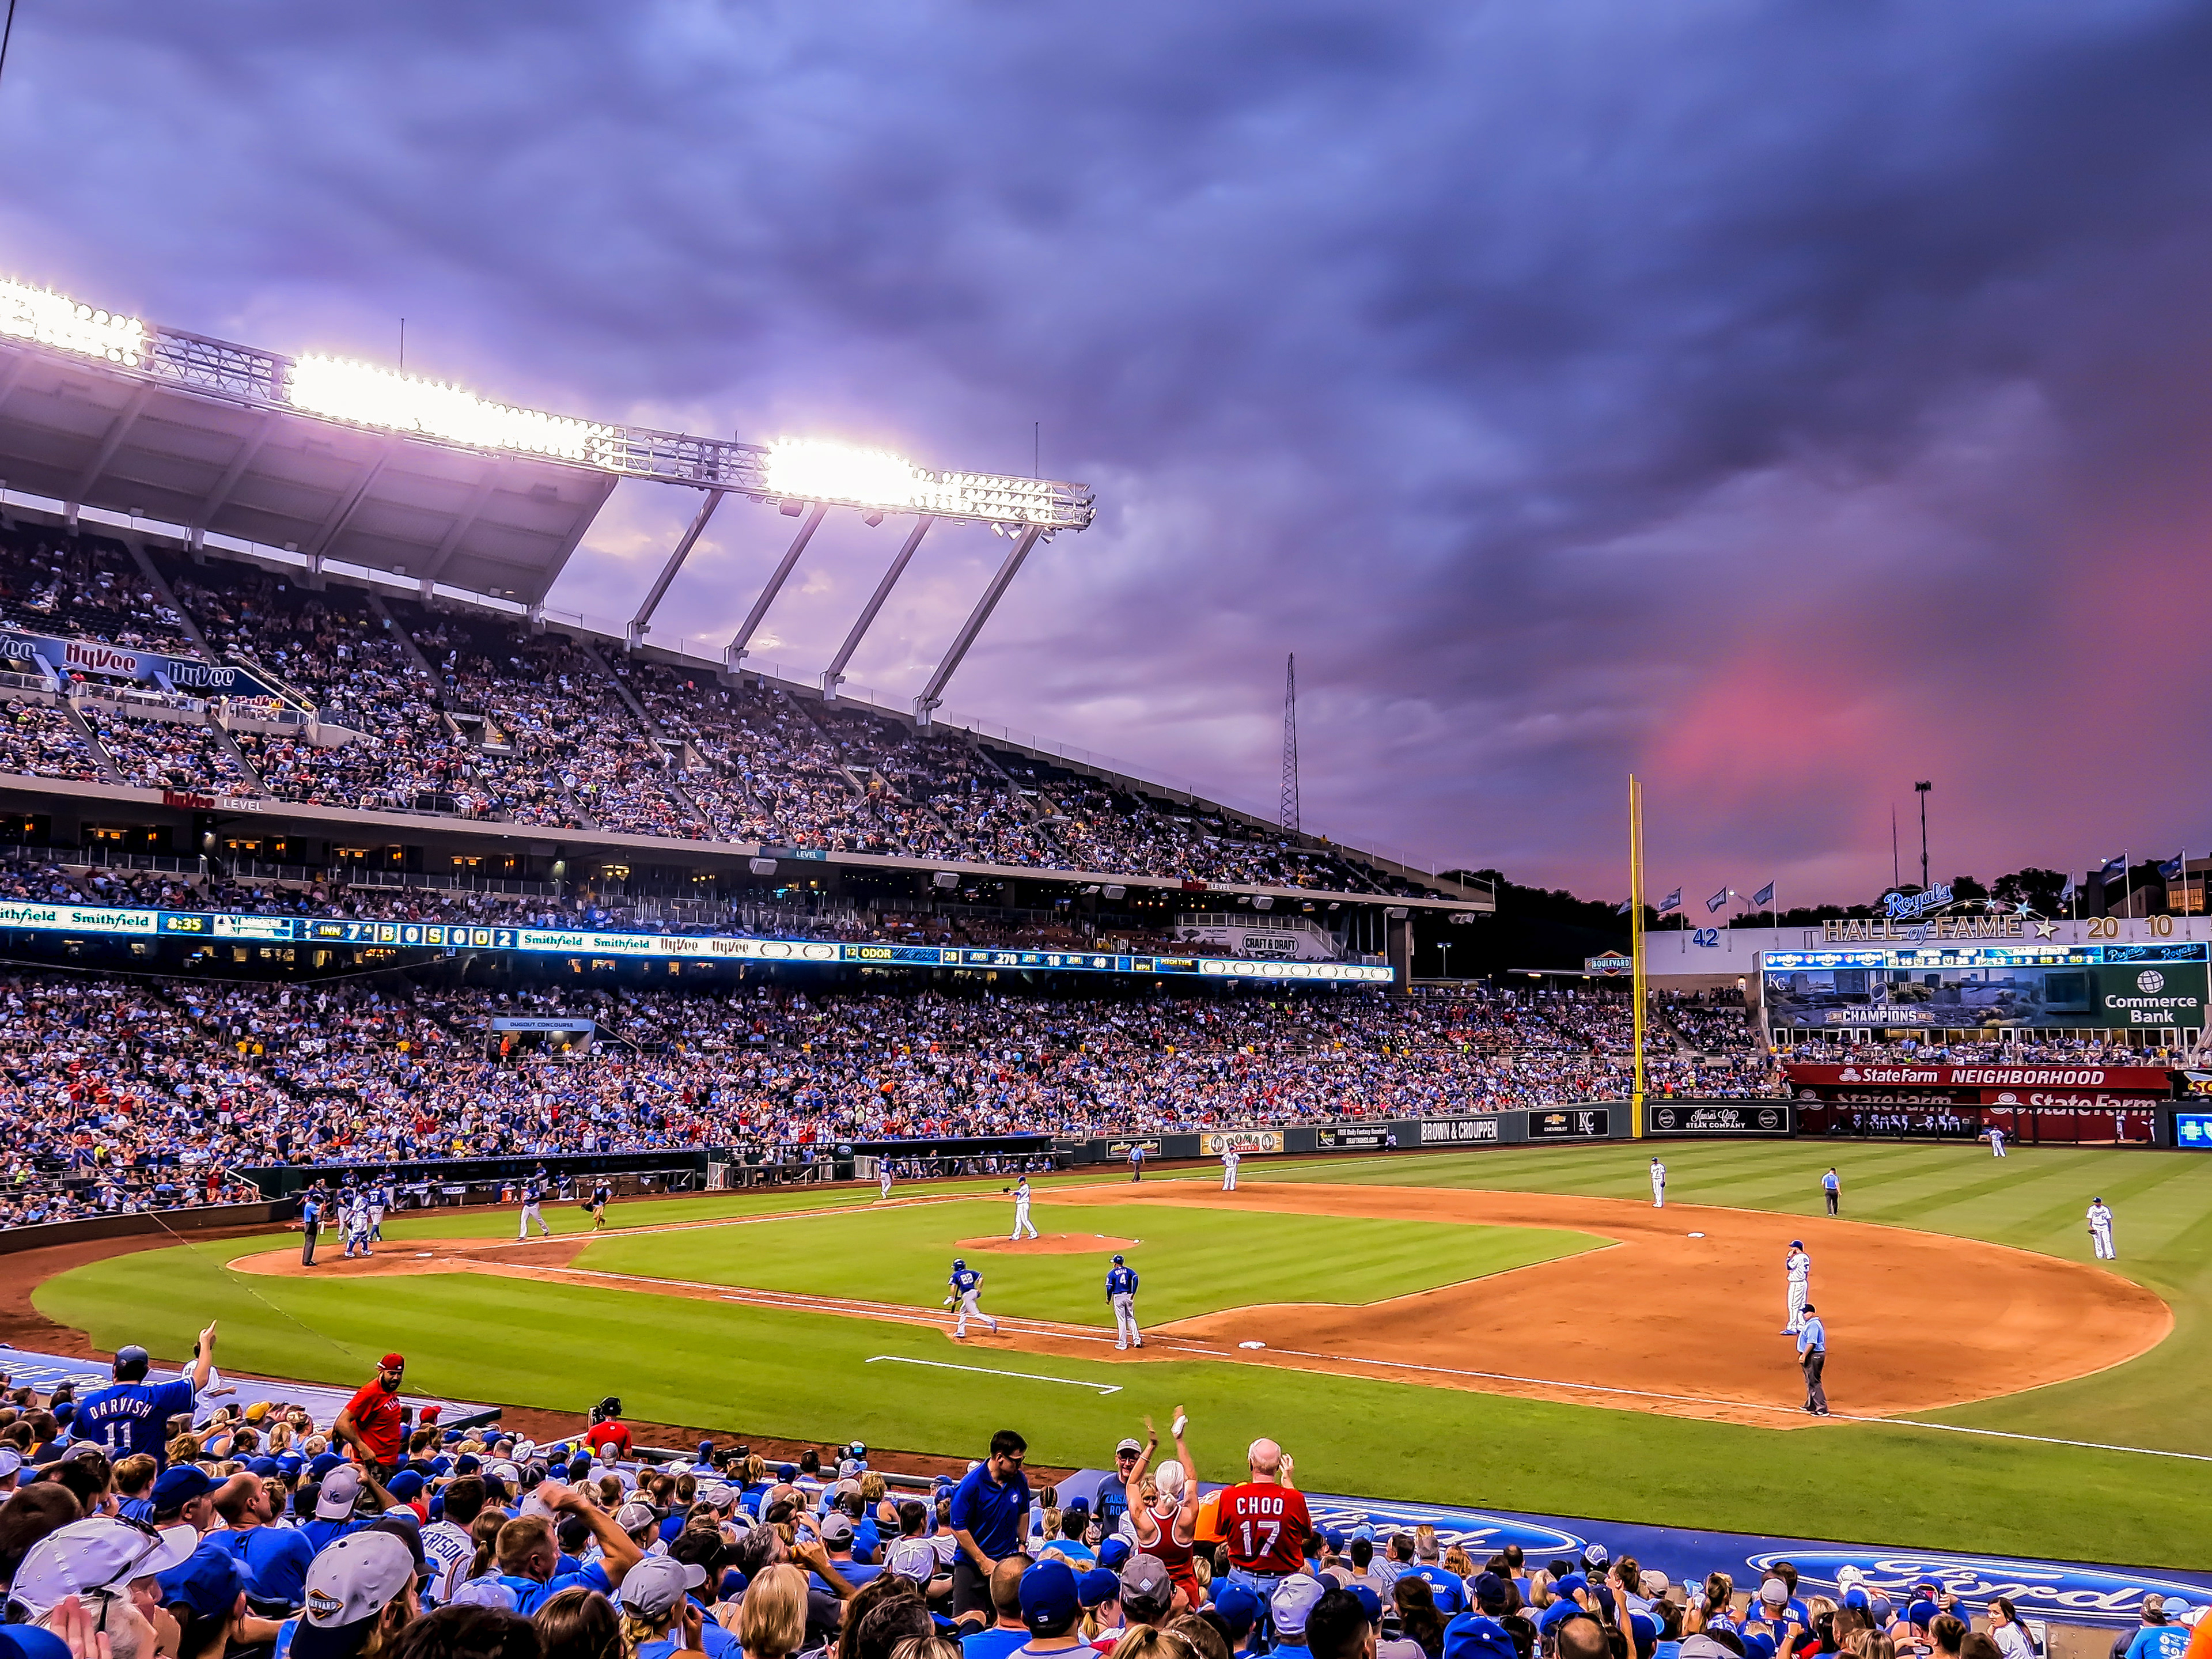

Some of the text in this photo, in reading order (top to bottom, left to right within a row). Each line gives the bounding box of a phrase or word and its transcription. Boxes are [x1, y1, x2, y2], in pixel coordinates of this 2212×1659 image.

[64, 642, 137, 673] HyVee
[168, 661, 236, 687] HyVee
[224, 798, 263, 812] LEVEL
[796, 850, 817, 859] LEVEL
[1211, 882, 1231, 891] LEVEL
[1884, 881, 1954, 919] Royals
[72, 912, 150, 929] Smithfield
[2086, 917, 2119, 939] 20
[2145, 915, 2173, 938] 10
[320, 926, 341, 935] INN
[347, 924, 361, 940] 7
[381, 926, 394, 941] B
[429, 928, 442, 944] S
[498, 931, 511, 946] 2
[1692, 927, 1720, 947] 42
[1822, 914, 2024, 945] HALL of FAME
[524, 935, 583, 949] Smithfield
[594, 938, 650, 951] Smithfield
[1245, 937, 1295, 950] CRAFT & DRAFT
[846, 948, 857, 956] 12
[861, 948, 892, 959] ODOR
[945, 952, 957, 961] 2B
[994, 953, 1017, 965] .270
[1593, 959, 1630, 968] BOULEVARD
[1767, 973, 1786, 991] KC
[2105, 994, 2198, 1008] Commerce
[1843, 1010, 1917, 1022] CHAMPIONS
[2130, 1009, 2175, 1024] Bank
[1950, 1069, 2105, 1085] NEIGHBORHOOD
[1422, 1120, 1497, 1141] BROWN & CROUPPEN
[1578, 1112, 1594, 1135] KC
[1226, 1133, 1260, 1148] ROMA
[1119, 1274, 1127, 1285] 4
[89, 1397, 153, 1420] DARVISH
[104, 1421, 132, 1450] 11
[1105, 1494, 1127, 1504] KANSA
[1237, 1498, 1283, 1515] CHOO
[1240, 1520, 1280, 1556] 17
[1858, 1559, 2145, 1611] Ford
